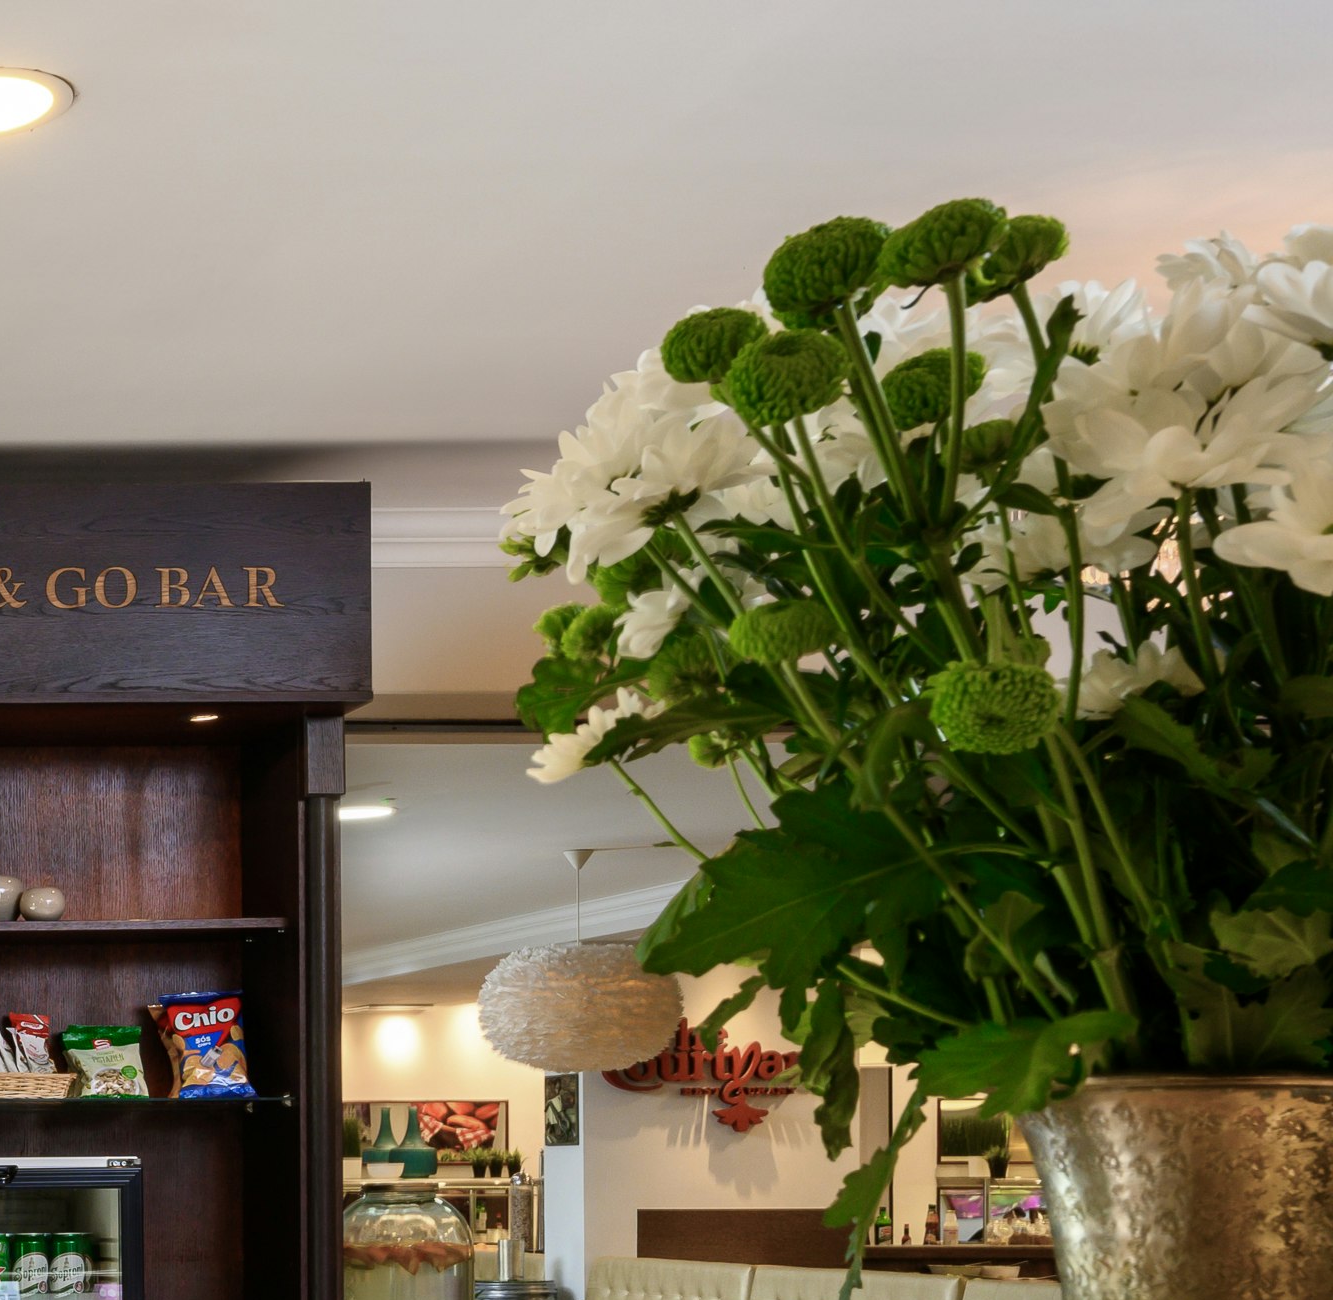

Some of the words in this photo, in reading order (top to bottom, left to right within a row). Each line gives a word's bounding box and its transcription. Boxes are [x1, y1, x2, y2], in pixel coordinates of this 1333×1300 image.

[44, 566, 138, 610] GO
[154, 566, 286, 610] BAR
[174, 1005, 235, 1031] Chio
[14, 1263, 47, 1283] Soproni
[51, 1263, 83, 1282] Soproni
